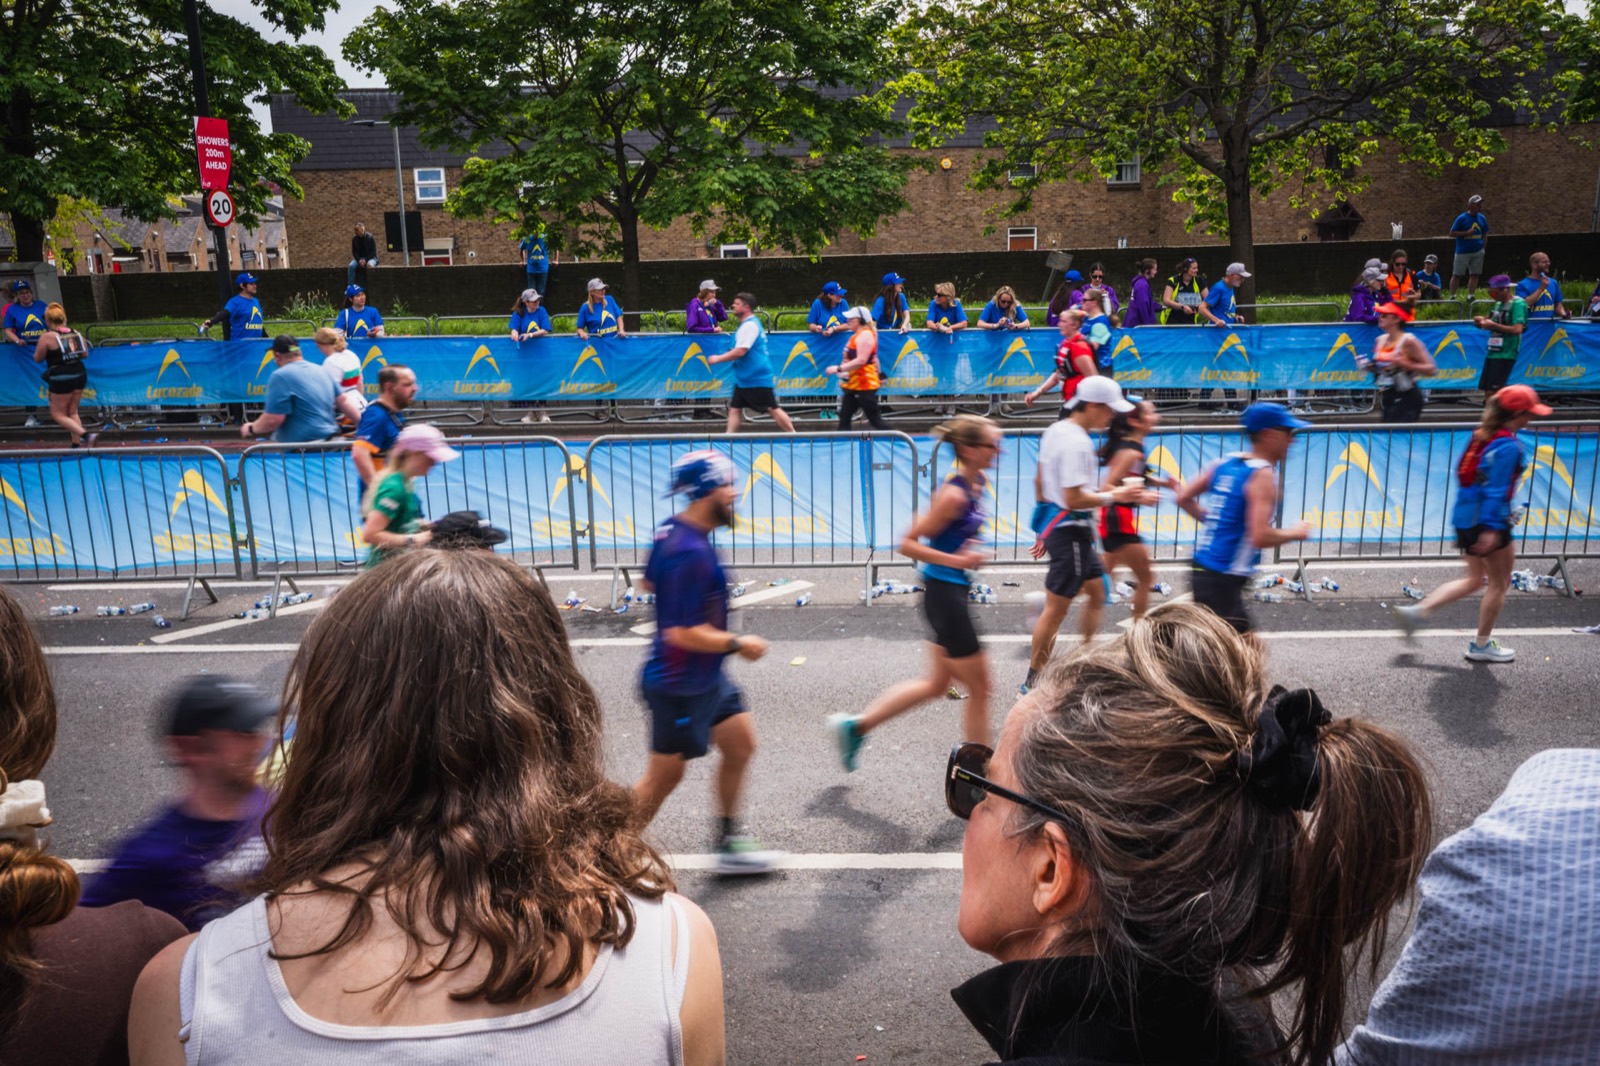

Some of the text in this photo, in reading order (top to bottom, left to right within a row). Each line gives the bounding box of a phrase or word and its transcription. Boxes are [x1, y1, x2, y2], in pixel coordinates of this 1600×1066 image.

[197, 135, 230, 147] SHOWERS
[205, 148, 225, 158] 200m
[205, 160, 228, 170] AHEAD
[212, 198, 231, 215] 20
[1200, 366, 1260, 383] Lucozade
[1525, 363, 1586, 378] Lucozade
[665, 377, 723, 391] Lucozade
[986, 372, 1045, 387] Lucozade
[146, 384, 203, 399] Lucozade
[454, 380, 511, 394] Lucozade
[559, 380, 618, 394] Lucozade
